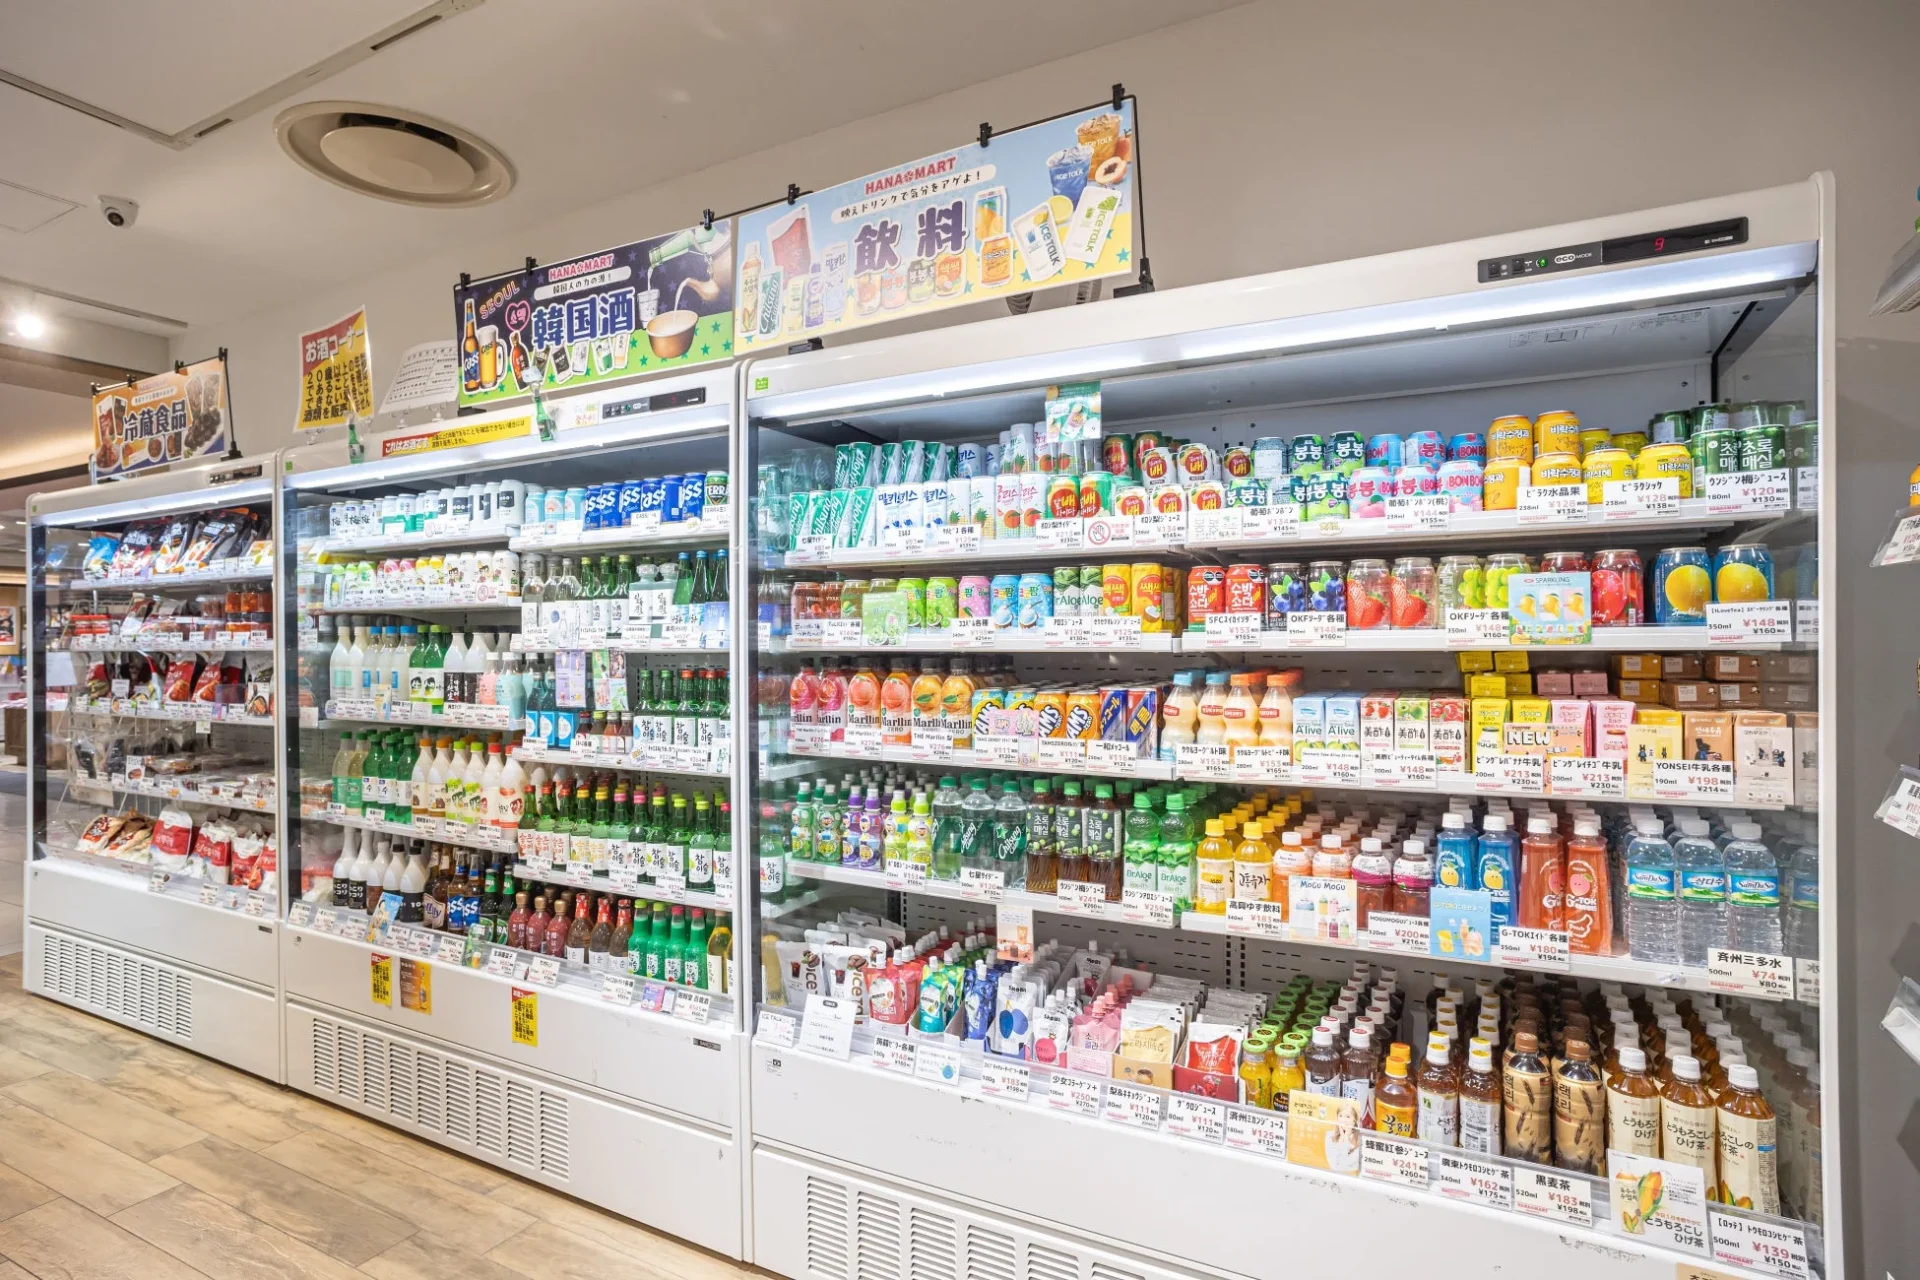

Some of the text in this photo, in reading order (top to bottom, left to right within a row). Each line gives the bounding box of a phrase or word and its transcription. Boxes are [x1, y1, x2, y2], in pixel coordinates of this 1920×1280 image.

[854, 200, 967, 275] 飲料
[533, 288, 634, 349] 韓国酒
[124, 400, 186, 441] 冷蔵食品
[1742, 487, 1774, 496] ¥120
[1743, 619, 1775, 627] ¥148
[1507, 730, 1552, 746] NEW
[1504, 770, 1530, 778] ¥213
[1582, 773, 1610, 782] ¥213
[1688, 776, 1718, 785] ¥198
[1530, 944, 1556, 954] ¥180
[1709, 968, 1732, 977] 500ml
[1752, 970, 1776, 980] ¥74
[1759, 980, 1778, 989] ¥80
[1251, 1128, 1274, 1140] ¥125
[1391, 1158, 1418, 1171] ¥241
[1470, 1177, 1498, 1191] ¥162
[1535, 1174, 1571, 1191] 黒麦茶
[1478, 1188, 1498, 1199] ¥175
[1516, 1188, 1538, 1199] 520ml
[1548, 1191, 1578, 1206] ¥183
[1557, 1204, 1578, 1214] ¥198
[1644, 1216, 1703, 1237] とうもろこし
[1674, 1232, 1704, 1249] ひげ茶
[1713, 1236, 1740, 1249] 500ml
[1752, 1240, 1789, 1259] ¥139
[1764, 1255, 1791, 1269] ¥150
